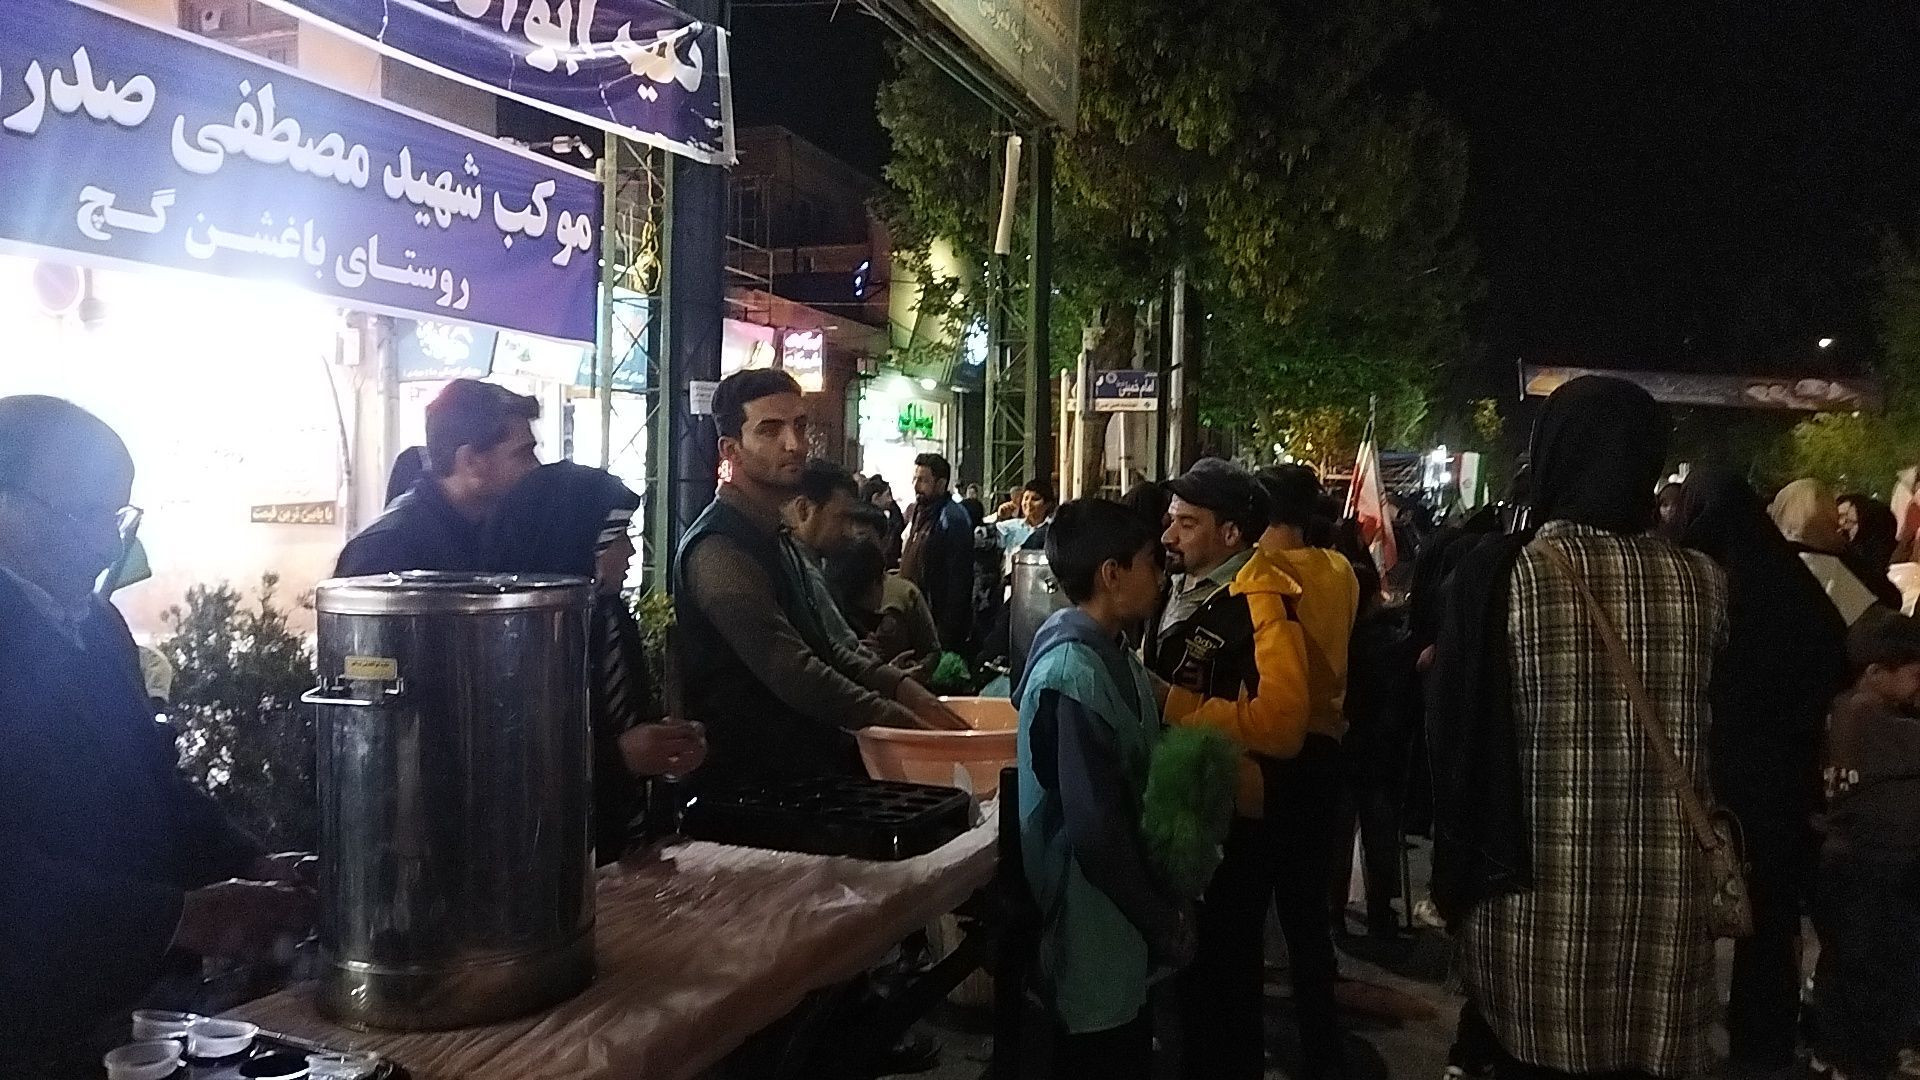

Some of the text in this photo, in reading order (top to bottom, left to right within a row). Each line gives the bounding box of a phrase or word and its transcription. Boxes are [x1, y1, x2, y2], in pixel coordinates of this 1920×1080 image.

[0, 46, 156, 134] صدر
[171, 79, 370, 189] مصطفی
[383, 145, 482, 229] شهید
[76, 184, 470, 310] روستای باغشن گچ
